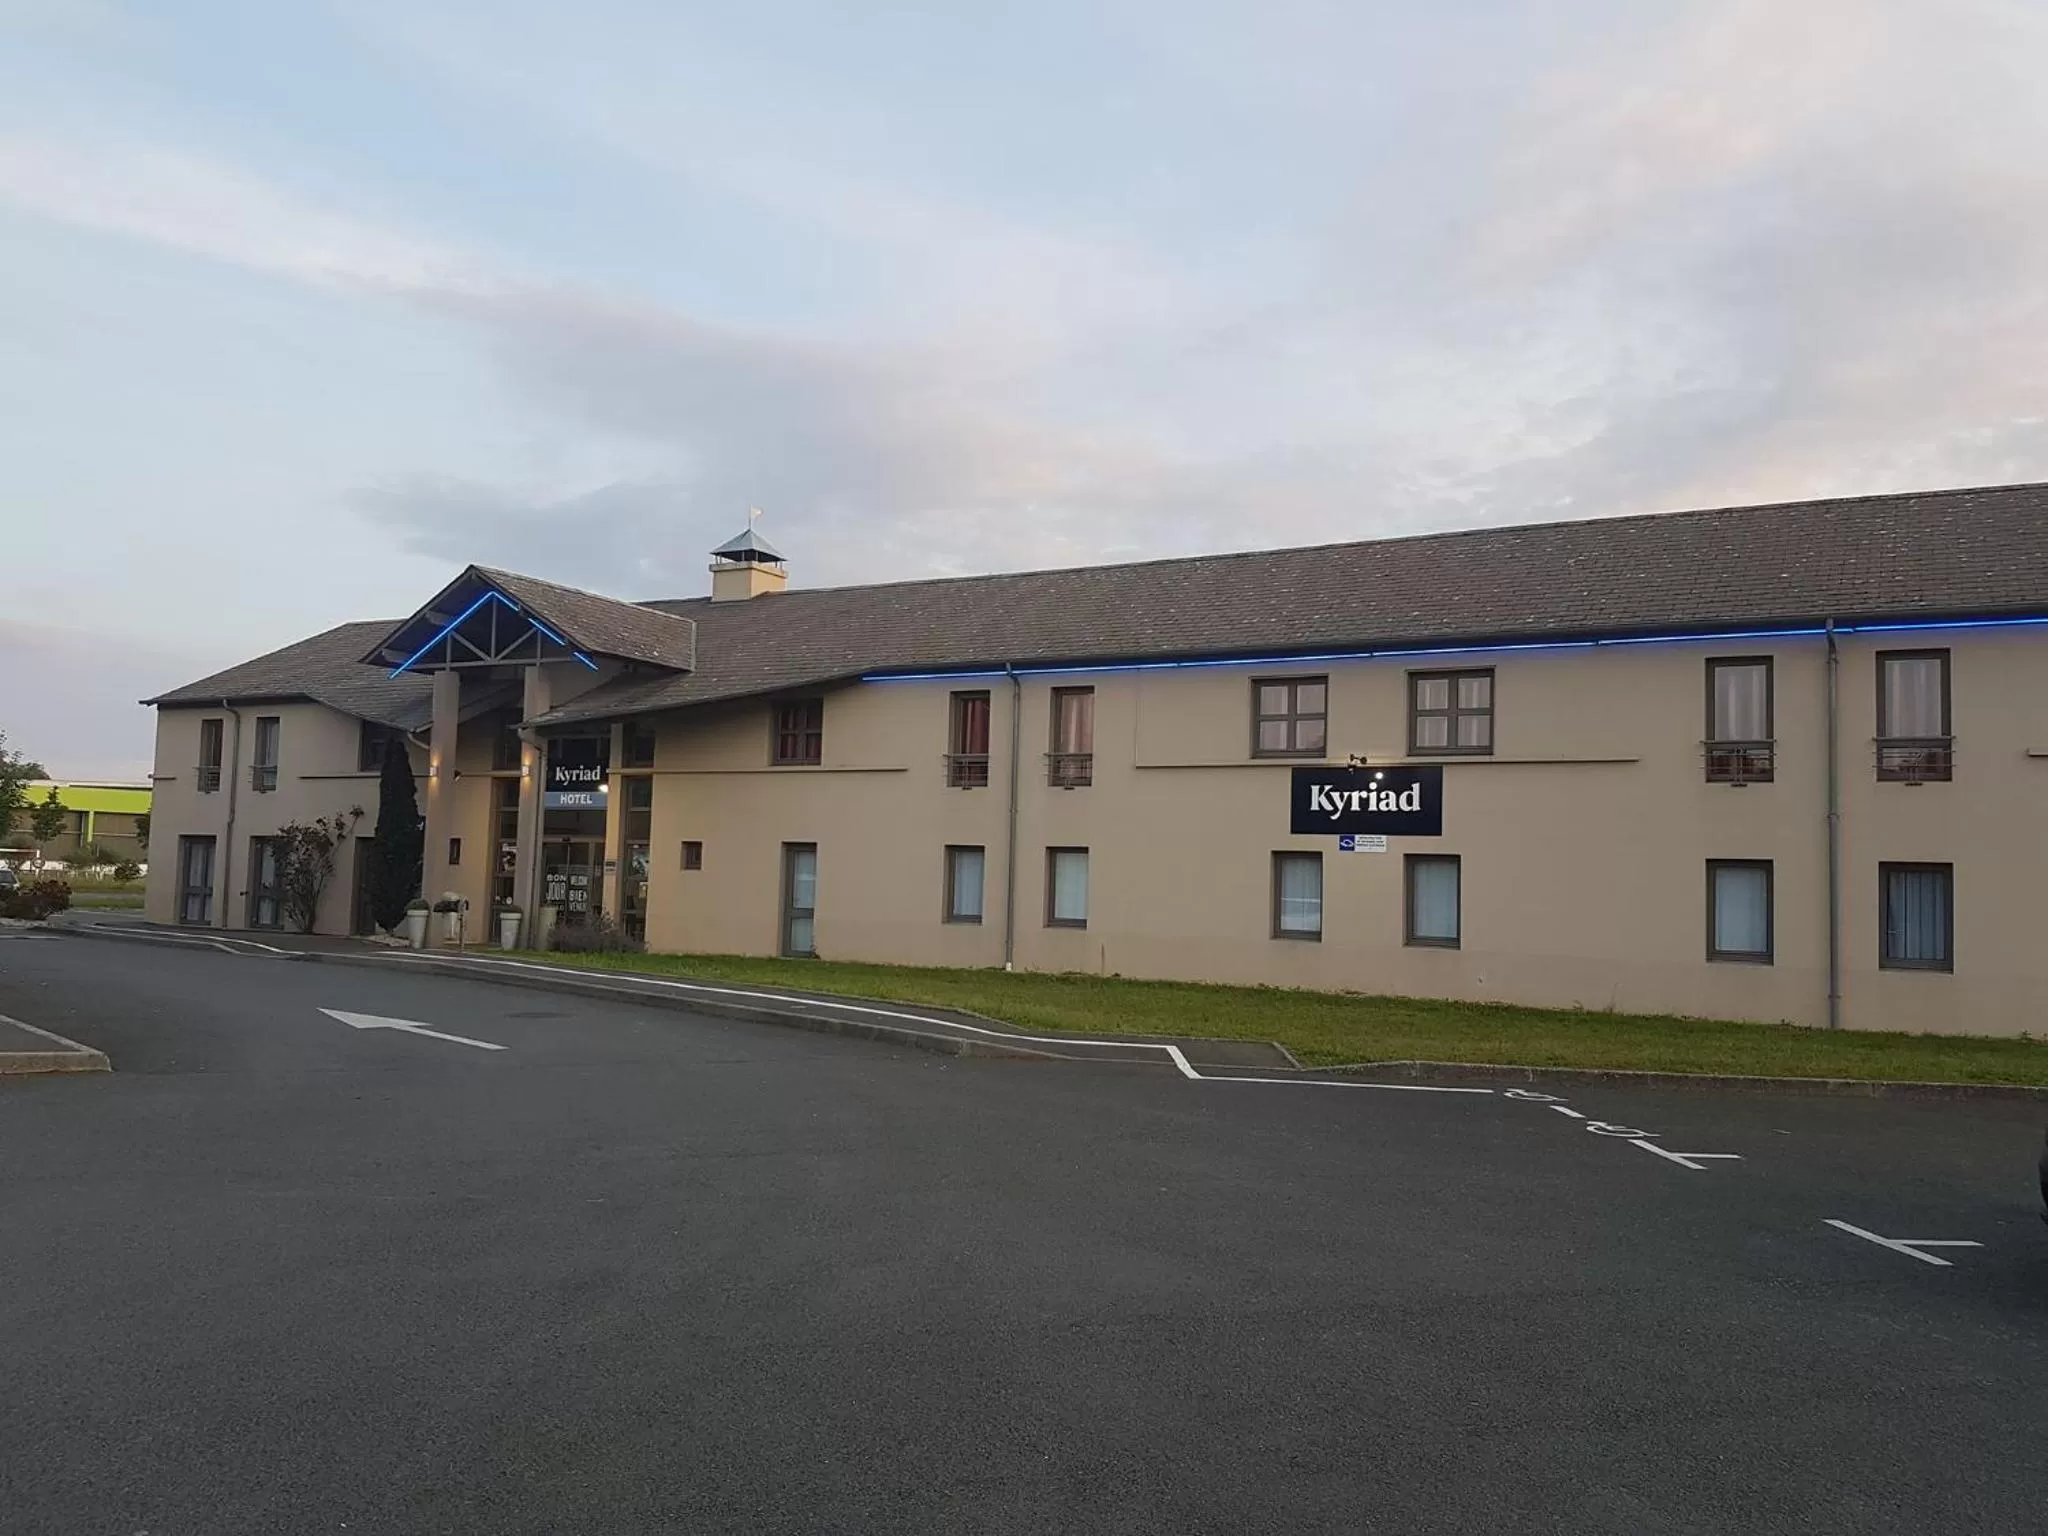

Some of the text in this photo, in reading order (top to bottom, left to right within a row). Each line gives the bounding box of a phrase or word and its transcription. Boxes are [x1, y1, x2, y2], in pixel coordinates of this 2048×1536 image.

[555, 765, 601, 786] Kyriad
[560, 793, 593, 805] HOTEL
[1310, 782, 1421, 820] Kyriad
